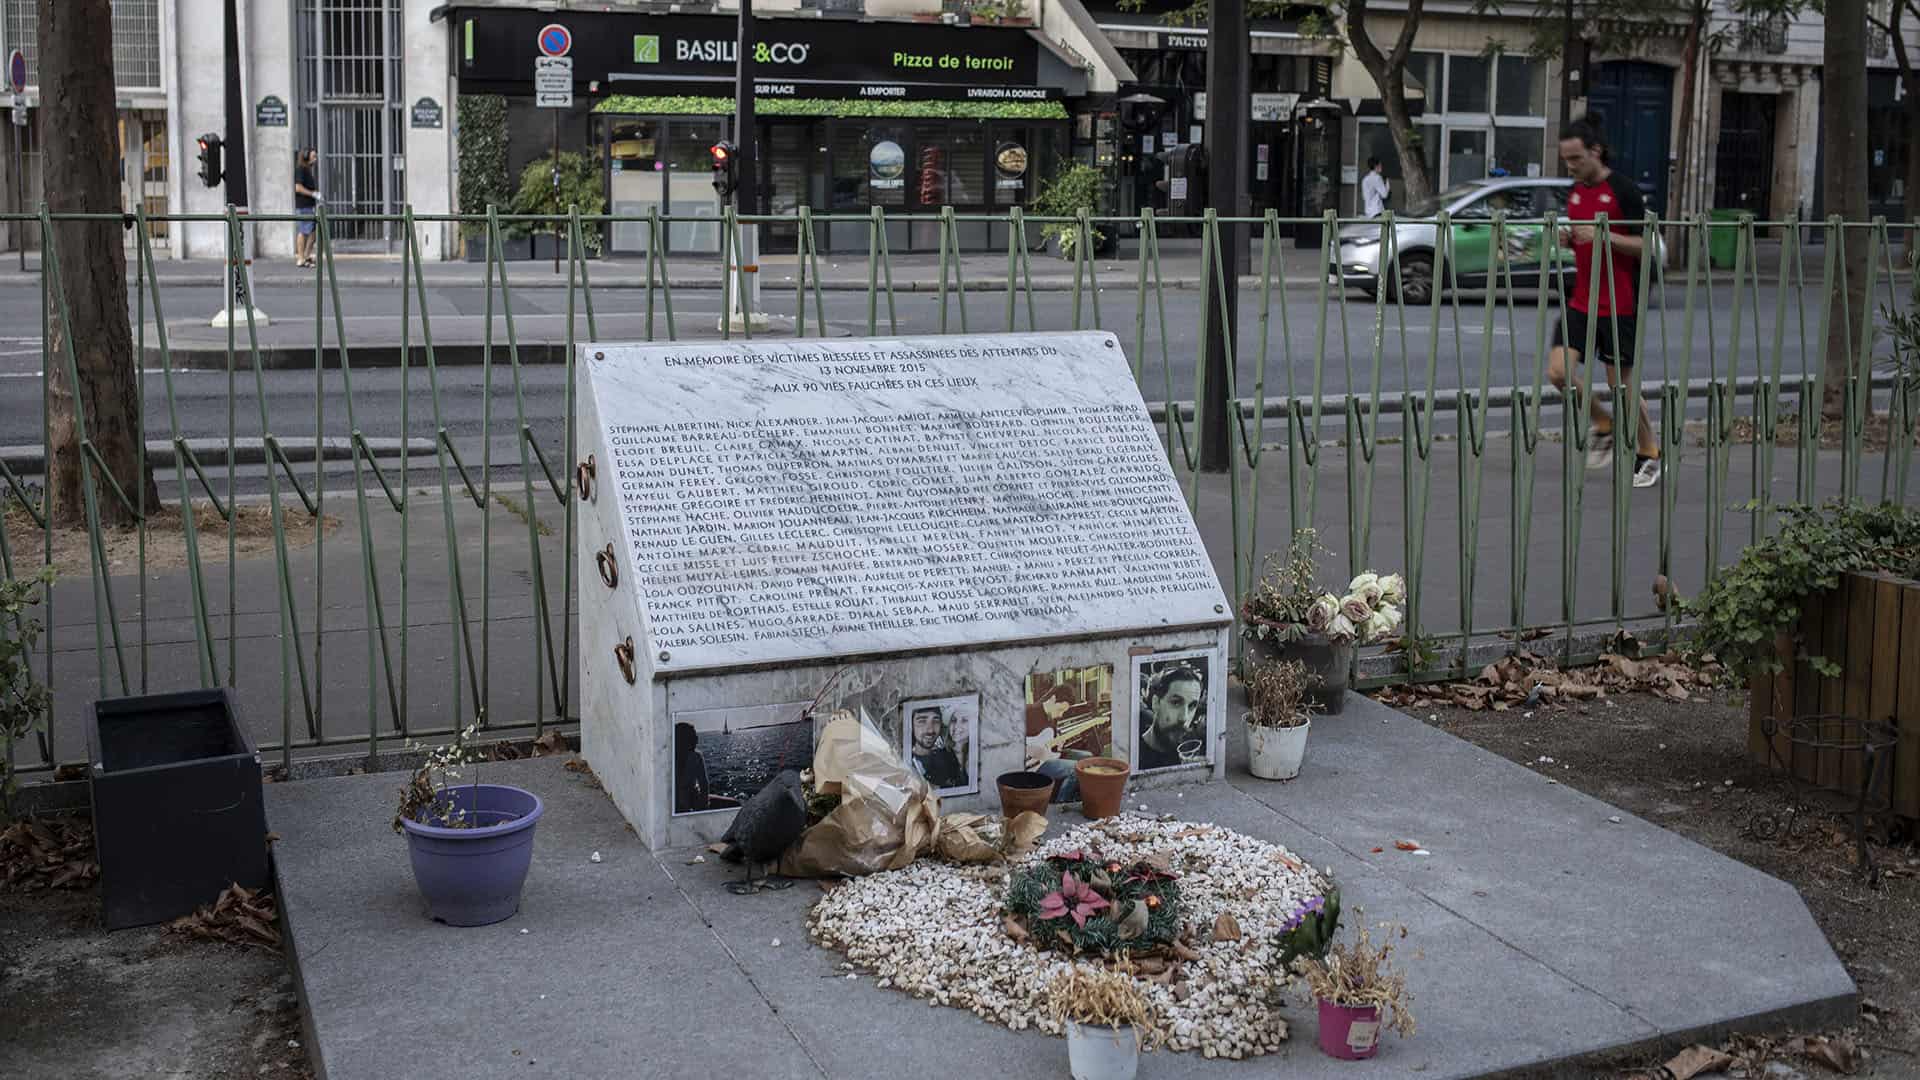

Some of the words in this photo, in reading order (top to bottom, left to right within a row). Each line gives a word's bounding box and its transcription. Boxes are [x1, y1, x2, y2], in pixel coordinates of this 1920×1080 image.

[676, 39, 807, 64] BASILI&CO
[893, 51, 933, 68] Pizza
[939, 53, 960, 69] de
[966, 53, 1014, 70] terroir
[754, 85, 770, 94] SUR
[771, 85, 795, 95] PLACE
[868, 87, 906, 97] EMPORTER
[968, 88, 1004, 98] LIVRAISON
[1012, 89, 1047, 99] DOMICILE
[664, 356, 681, 366] EN
[743, 354, 764, 363] DES
[766, 353, 819, 363] VICTIMES
[959, 349, 979, 357] DES
[980, 347, 1038, 357] ATTENTATS
[1038, 347, 1058, 355] DU
[818, 366, 831, 374] 13
[834, 364, 896, 374] NOVEMBRE
[899, 363, 926, 372] 2015
[772, 383, 799, 392] AUX
[803, 382, 817, 391] 90
[821, 382, 845, 390] VIES
[847, 380, 903, 389] FAUCHÉES
[906, 379, 921, 387] EN
[924, 378, 944, 387] CES
[946, 377, 978, 386] LIEUX
